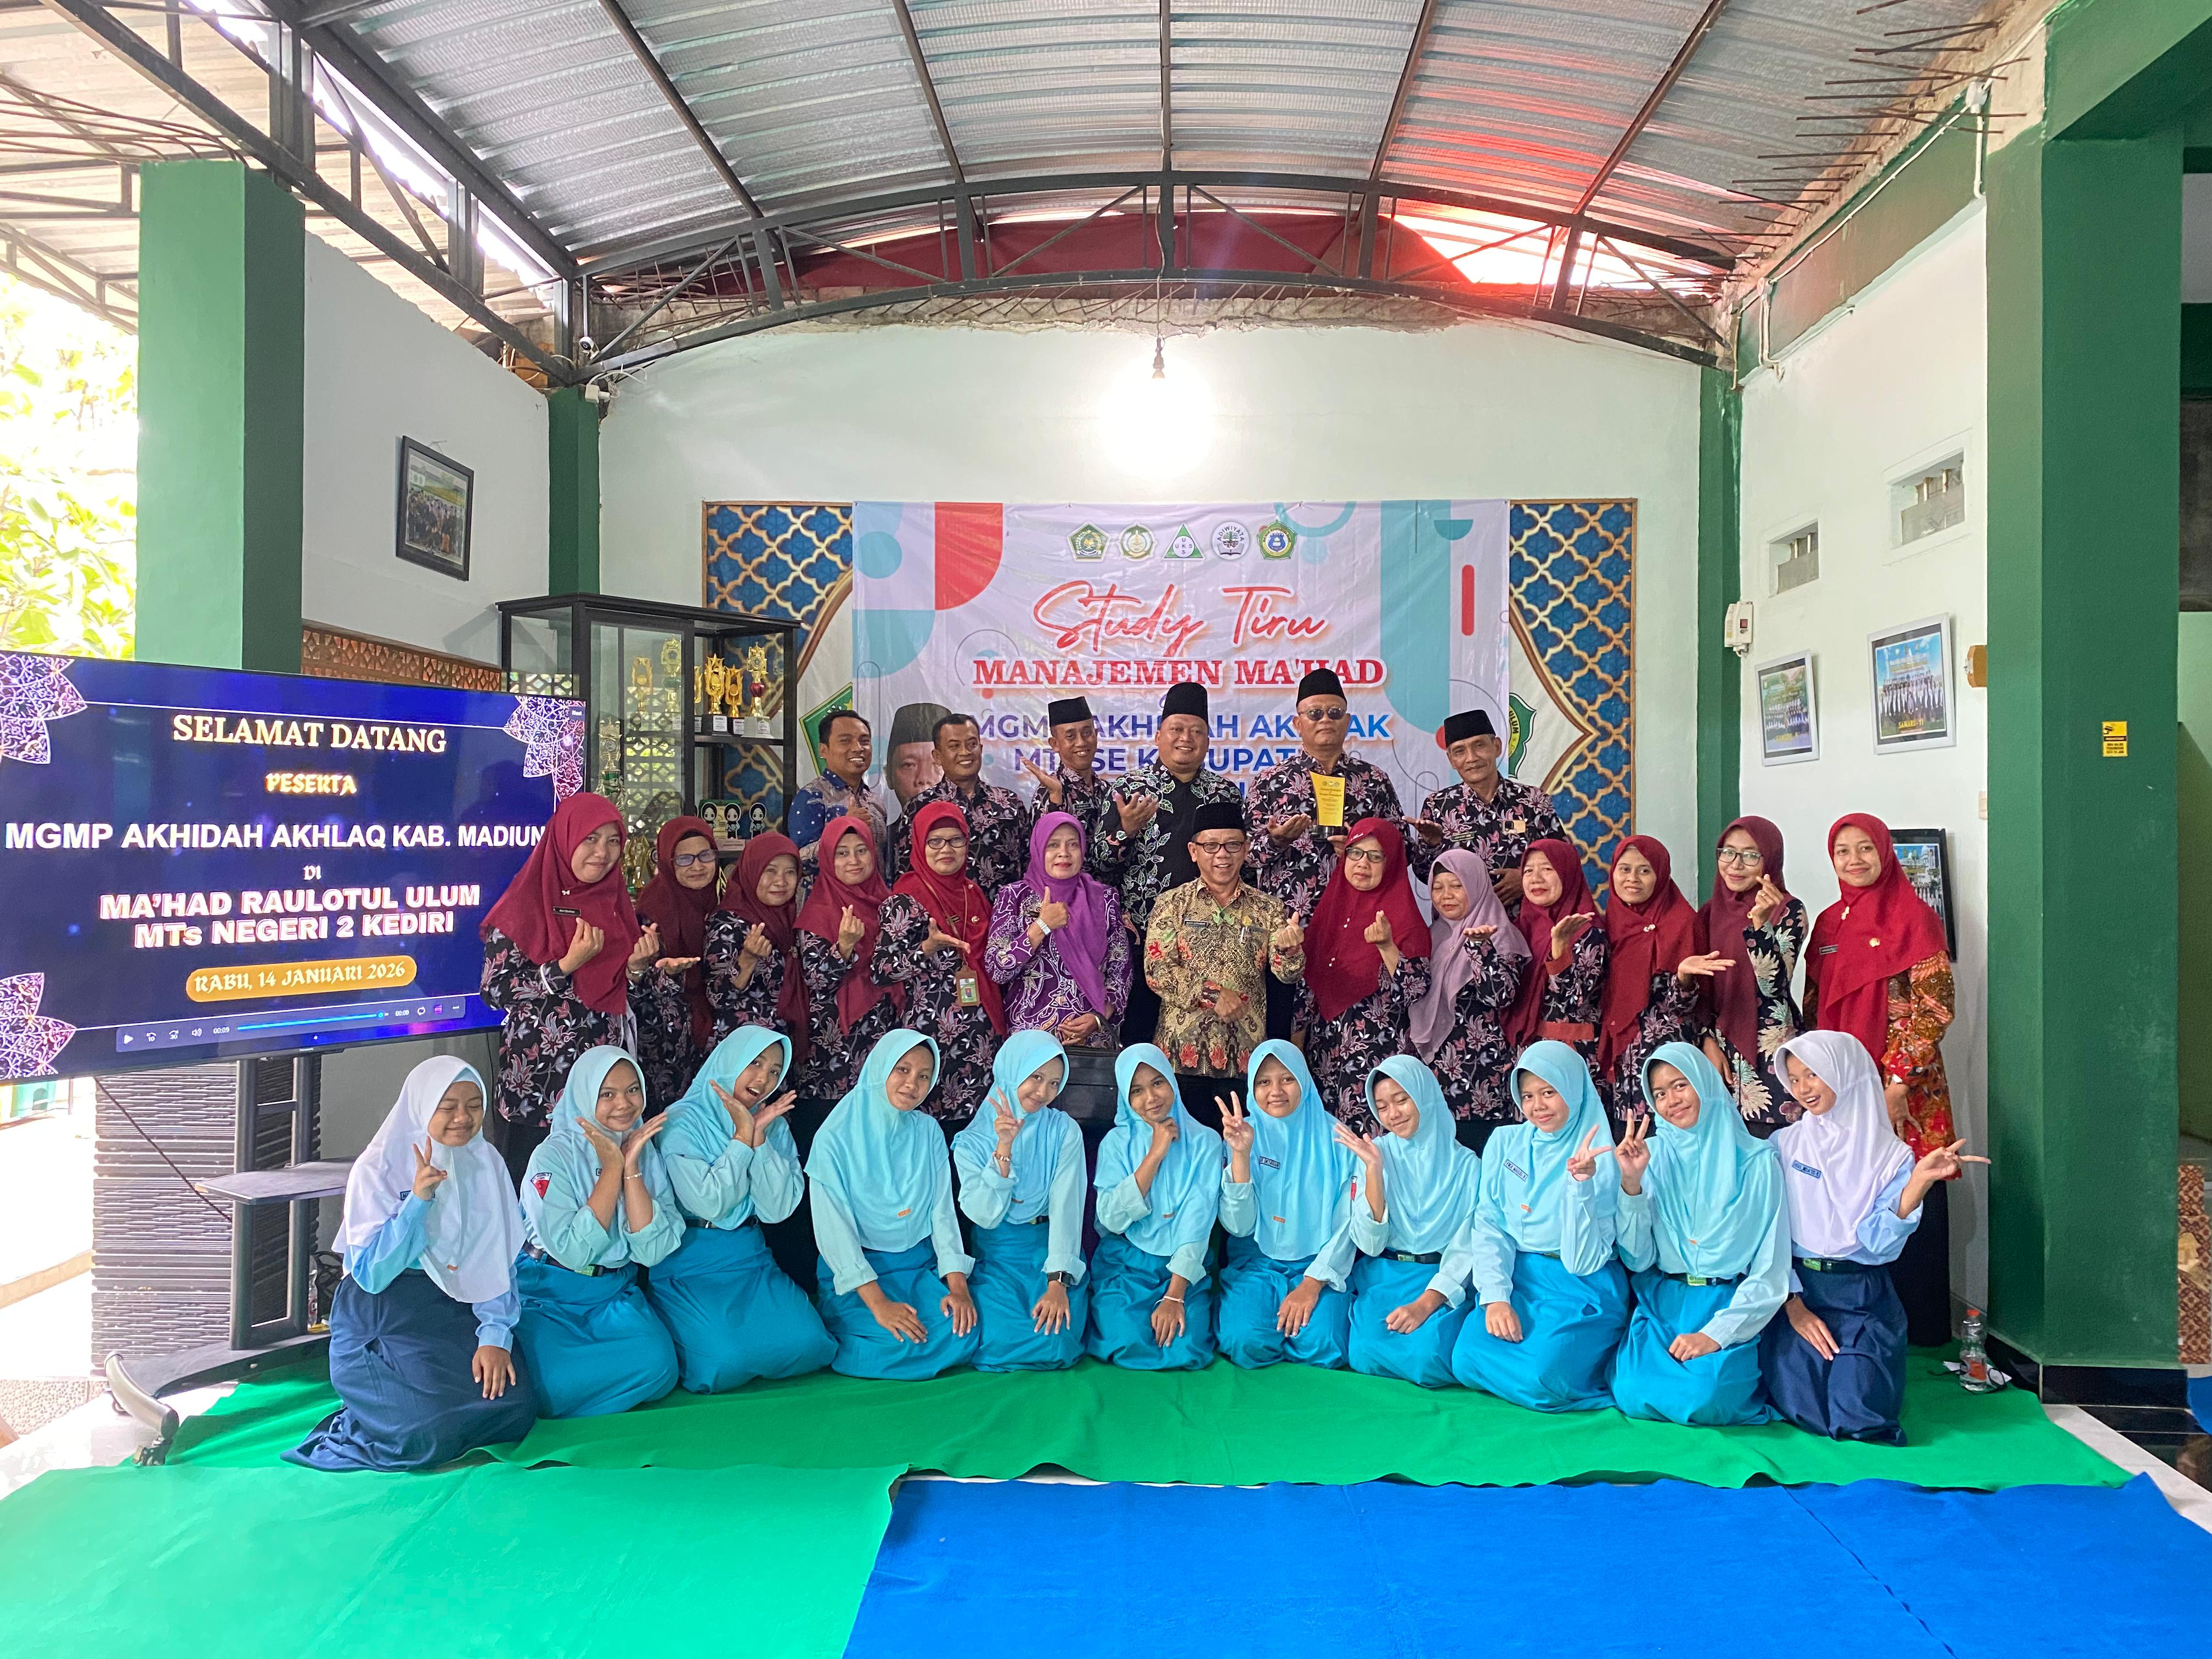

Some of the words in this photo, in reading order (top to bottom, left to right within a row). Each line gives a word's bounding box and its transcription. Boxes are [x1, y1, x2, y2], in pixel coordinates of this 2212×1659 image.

[1217, 525, 1245, 541] ADIWIYATA
[1034, 580, 1204, 657] Study
[1222, 586, 1325, 645] Tiru
[973, 659, 1223, 685] MANAJEMEN
[173, 715, 324, 747] SELAMAT
[330, 724, 448, 753] DATANG
[970, 715, 1048, 738] MGM
[266, 772, 358, 796] PESERTA
[5, 822, 114, 849] MGMP
[120, 823, 264, 849] AKHIDAH
[270, 824, 386, 849] AKHLAQ
[392, 825, 452, 848] KAB.
[458, 825, 546, 847] MADIUN
[303, 865, 322, 881] DI
[241, 887, 399, 915] RAULOTUL
[405, 884, 481, 907] ULUM
[134, 921, 203, 949] MTs
[211, 917, 329, 945] NEGERI
[335, 915, 355, 938] 2
[362, 911, 455, 934] KEDIRI
[194, 972, 253, 994] RABU,
[258, 970, 276, 988] 14
[281, 964, 363, 989] JANUARI
[366, 961, 406, 980] 2026
